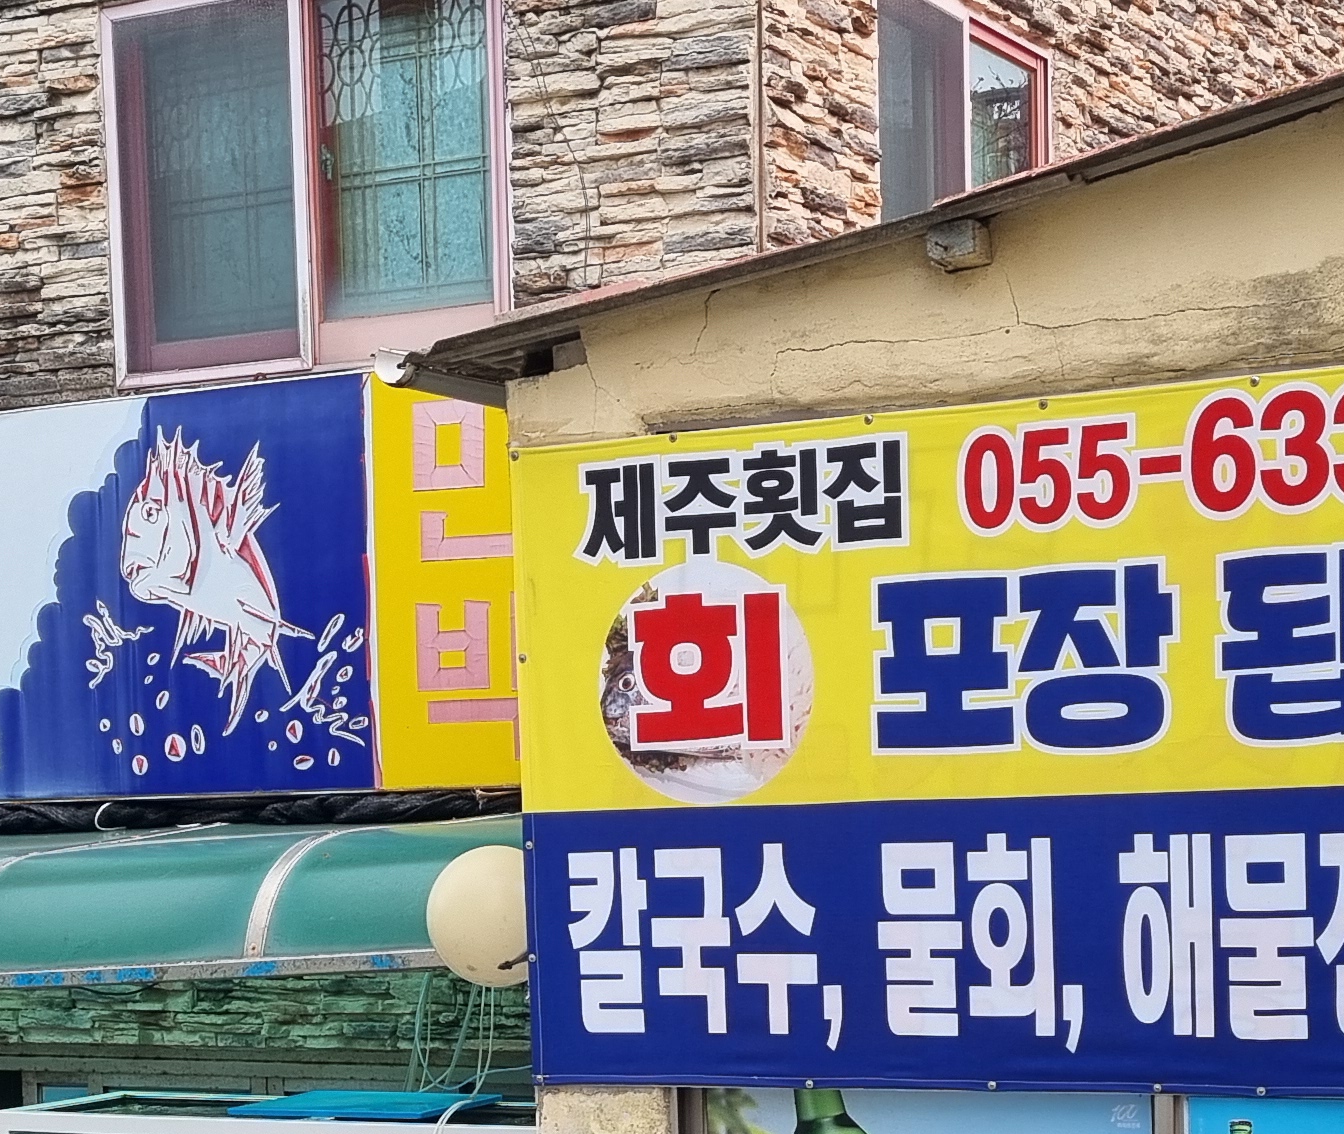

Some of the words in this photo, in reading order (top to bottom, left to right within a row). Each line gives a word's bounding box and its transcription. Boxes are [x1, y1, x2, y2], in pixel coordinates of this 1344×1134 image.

[582, 438, 903, 560] 제주횟집
[634, 593, 784, 743] 회
[876, 563, 1174, 750] 포장
[568, 843, 844, 1051] 칼국수,
[877, 833, 1084, 1053] 물회,
